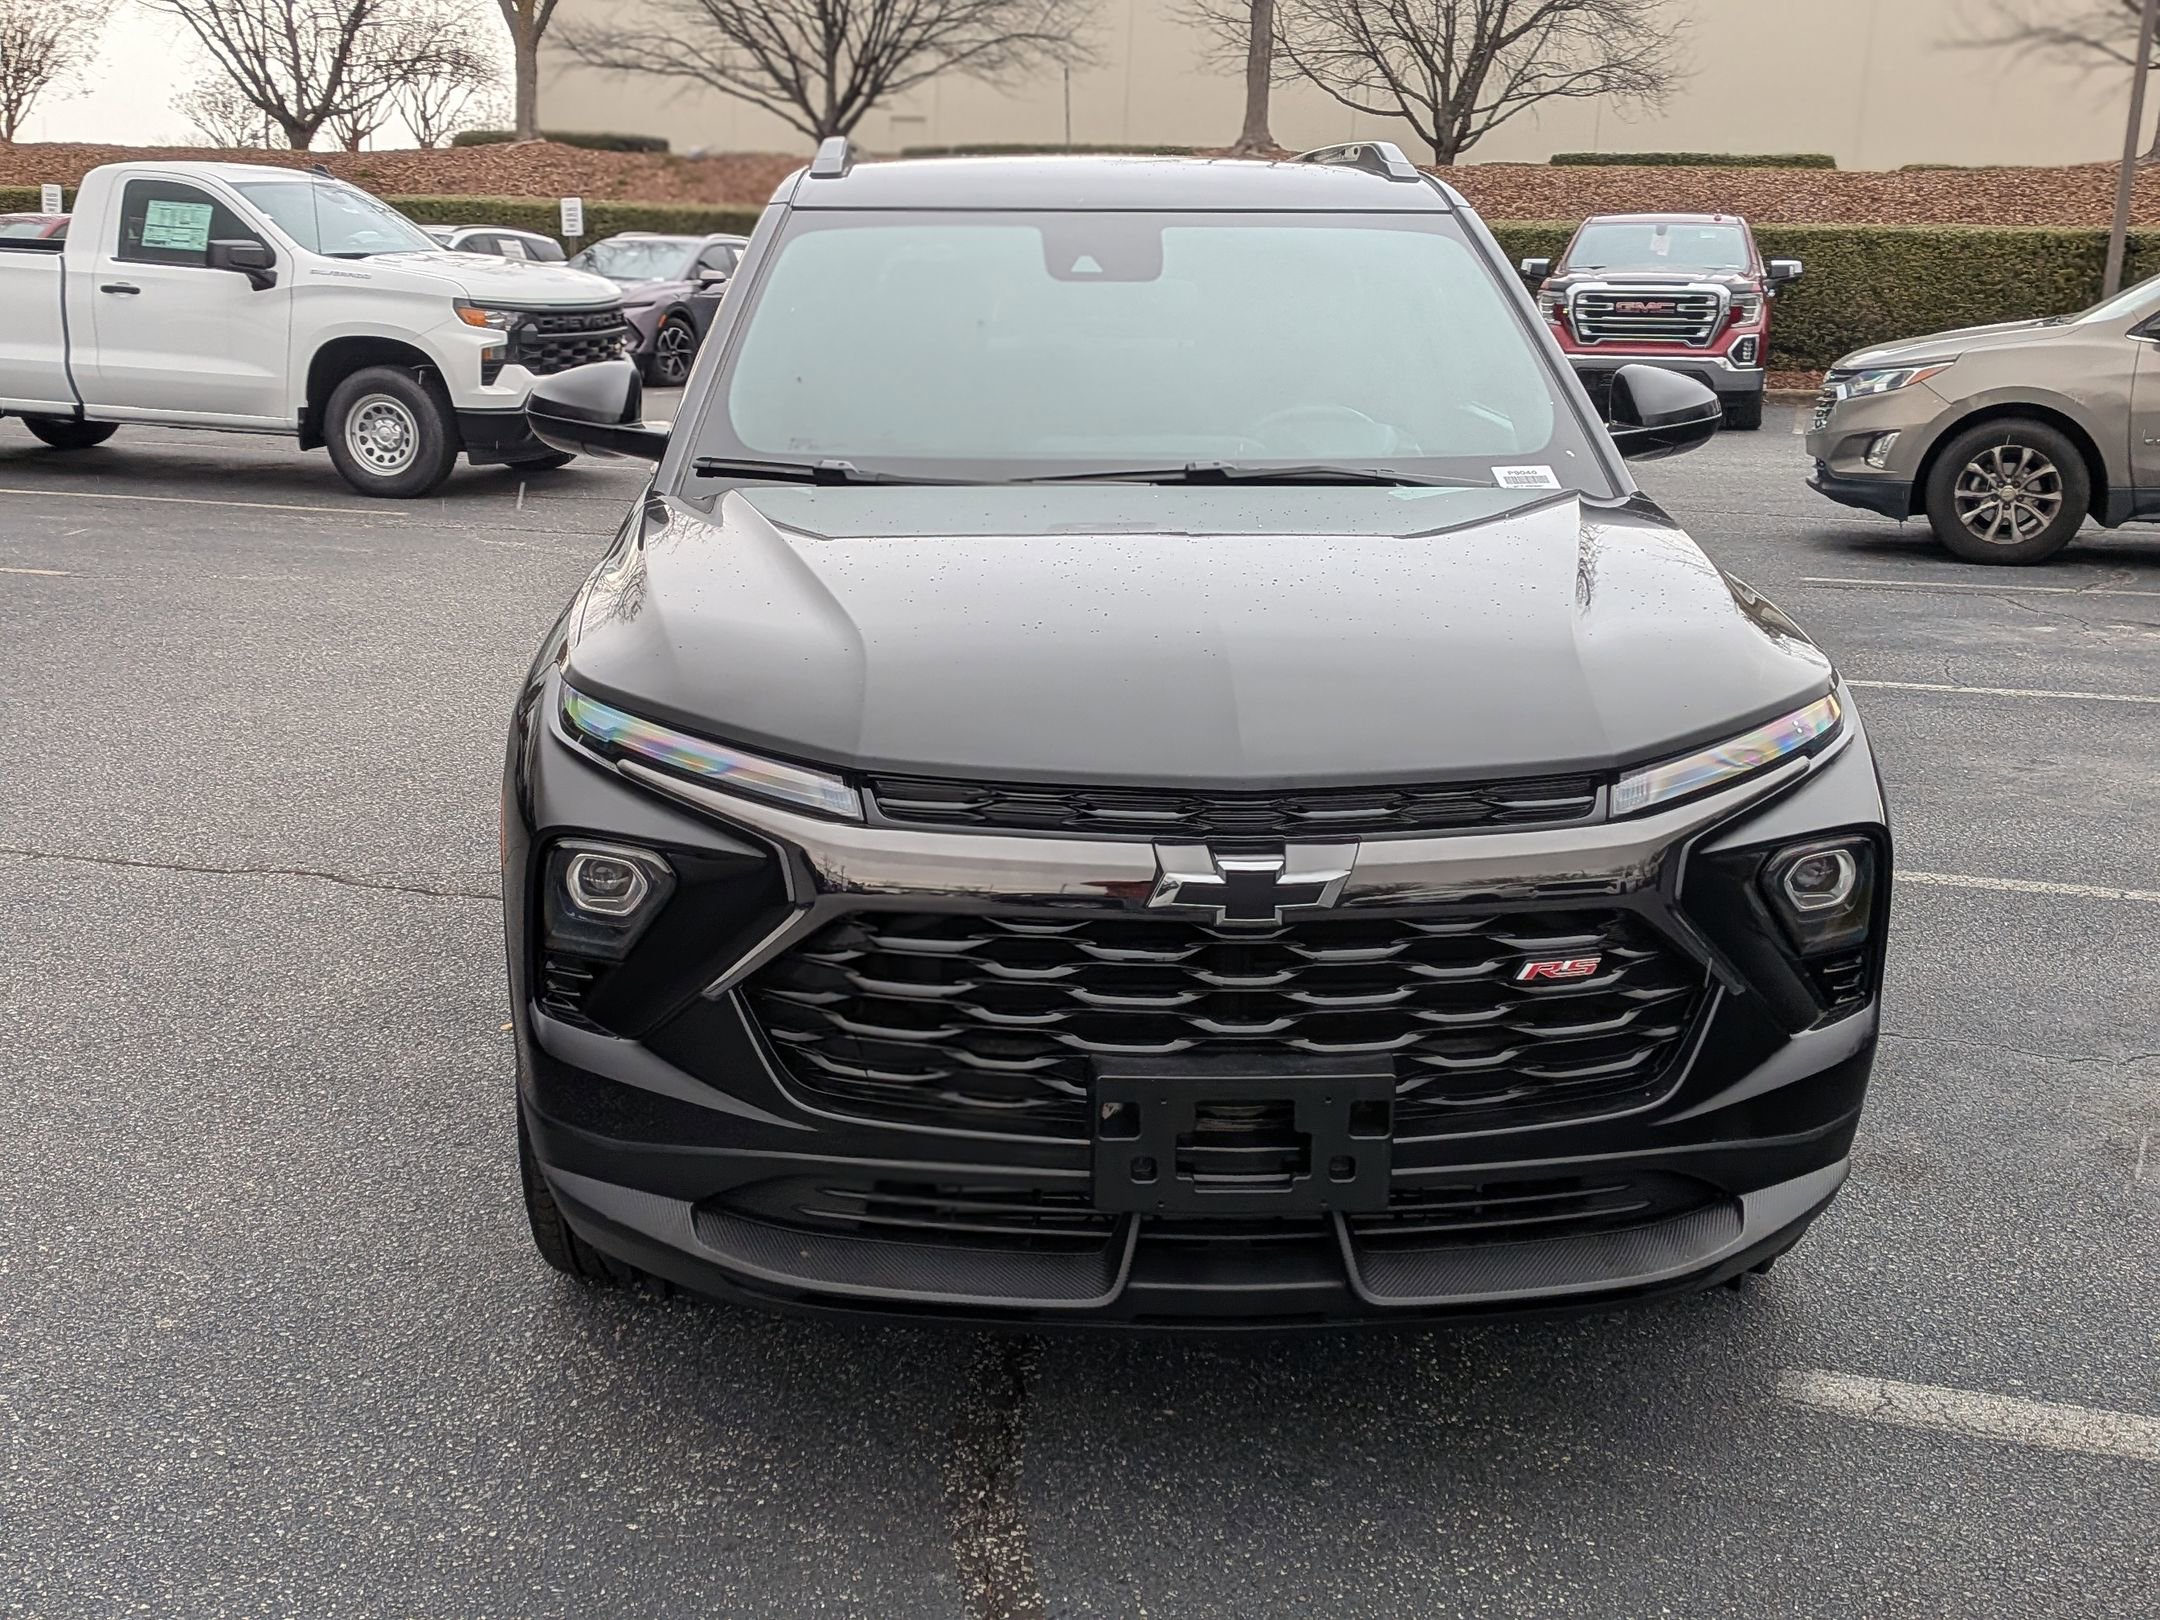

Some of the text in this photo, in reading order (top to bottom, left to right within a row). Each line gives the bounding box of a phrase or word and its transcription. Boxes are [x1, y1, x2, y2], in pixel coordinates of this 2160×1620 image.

[1615, 301, 1676, 314] GMC
[538, 312, 624, 330] CHEVROLE
[1515, 957, 1602, 981] RS
